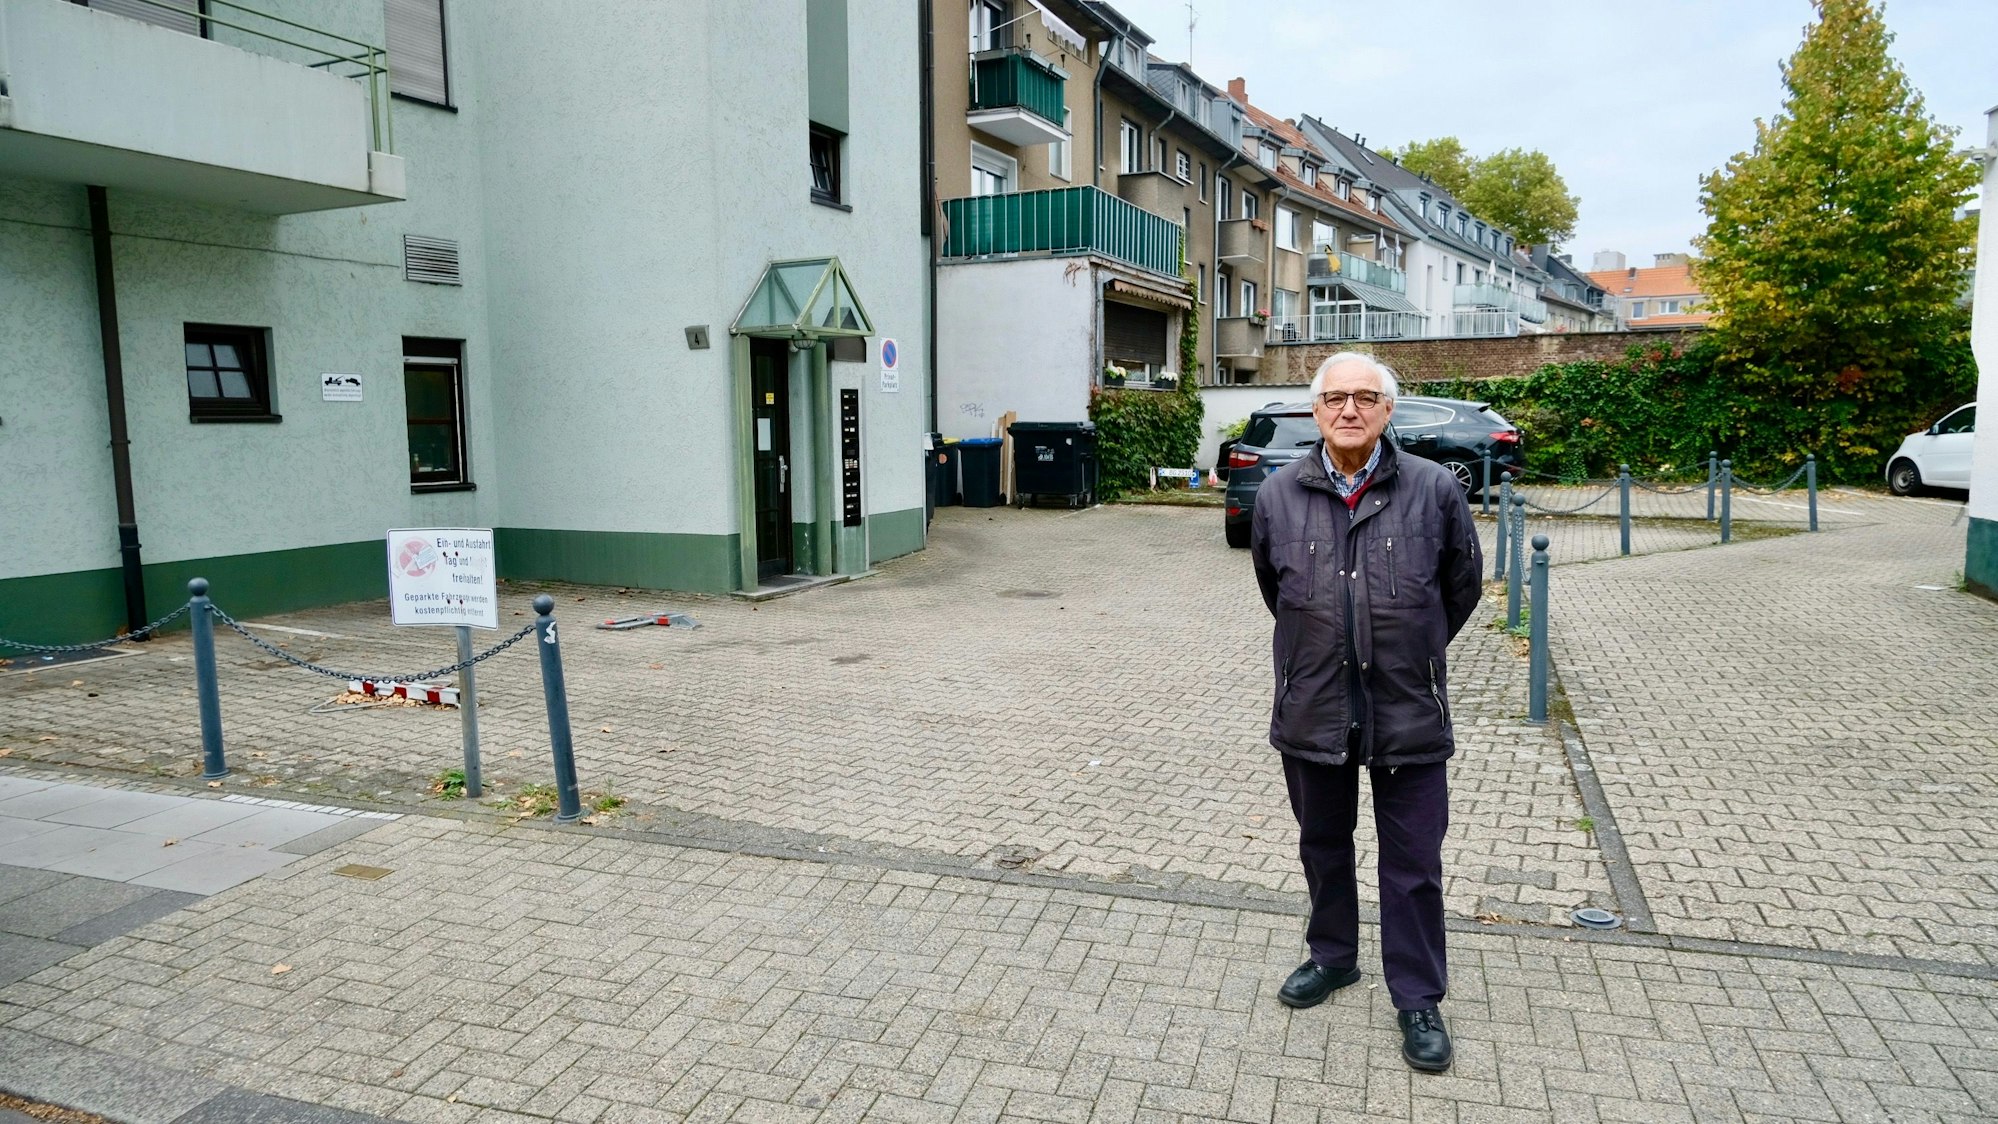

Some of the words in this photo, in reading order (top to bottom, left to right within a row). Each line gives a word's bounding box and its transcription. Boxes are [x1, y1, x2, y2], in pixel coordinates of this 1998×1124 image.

[694, 332, 700, 346] 4
[436, 538, 451, 548] Ein-
[453, 538, 464, 548] und
[465, 538, 491, 550] Ausfahrt
[444, 555, 457, 568] Tag
[404, 593, 440, 602] Geparkte
[414, 607, 467, 616] kostenpflichtig
